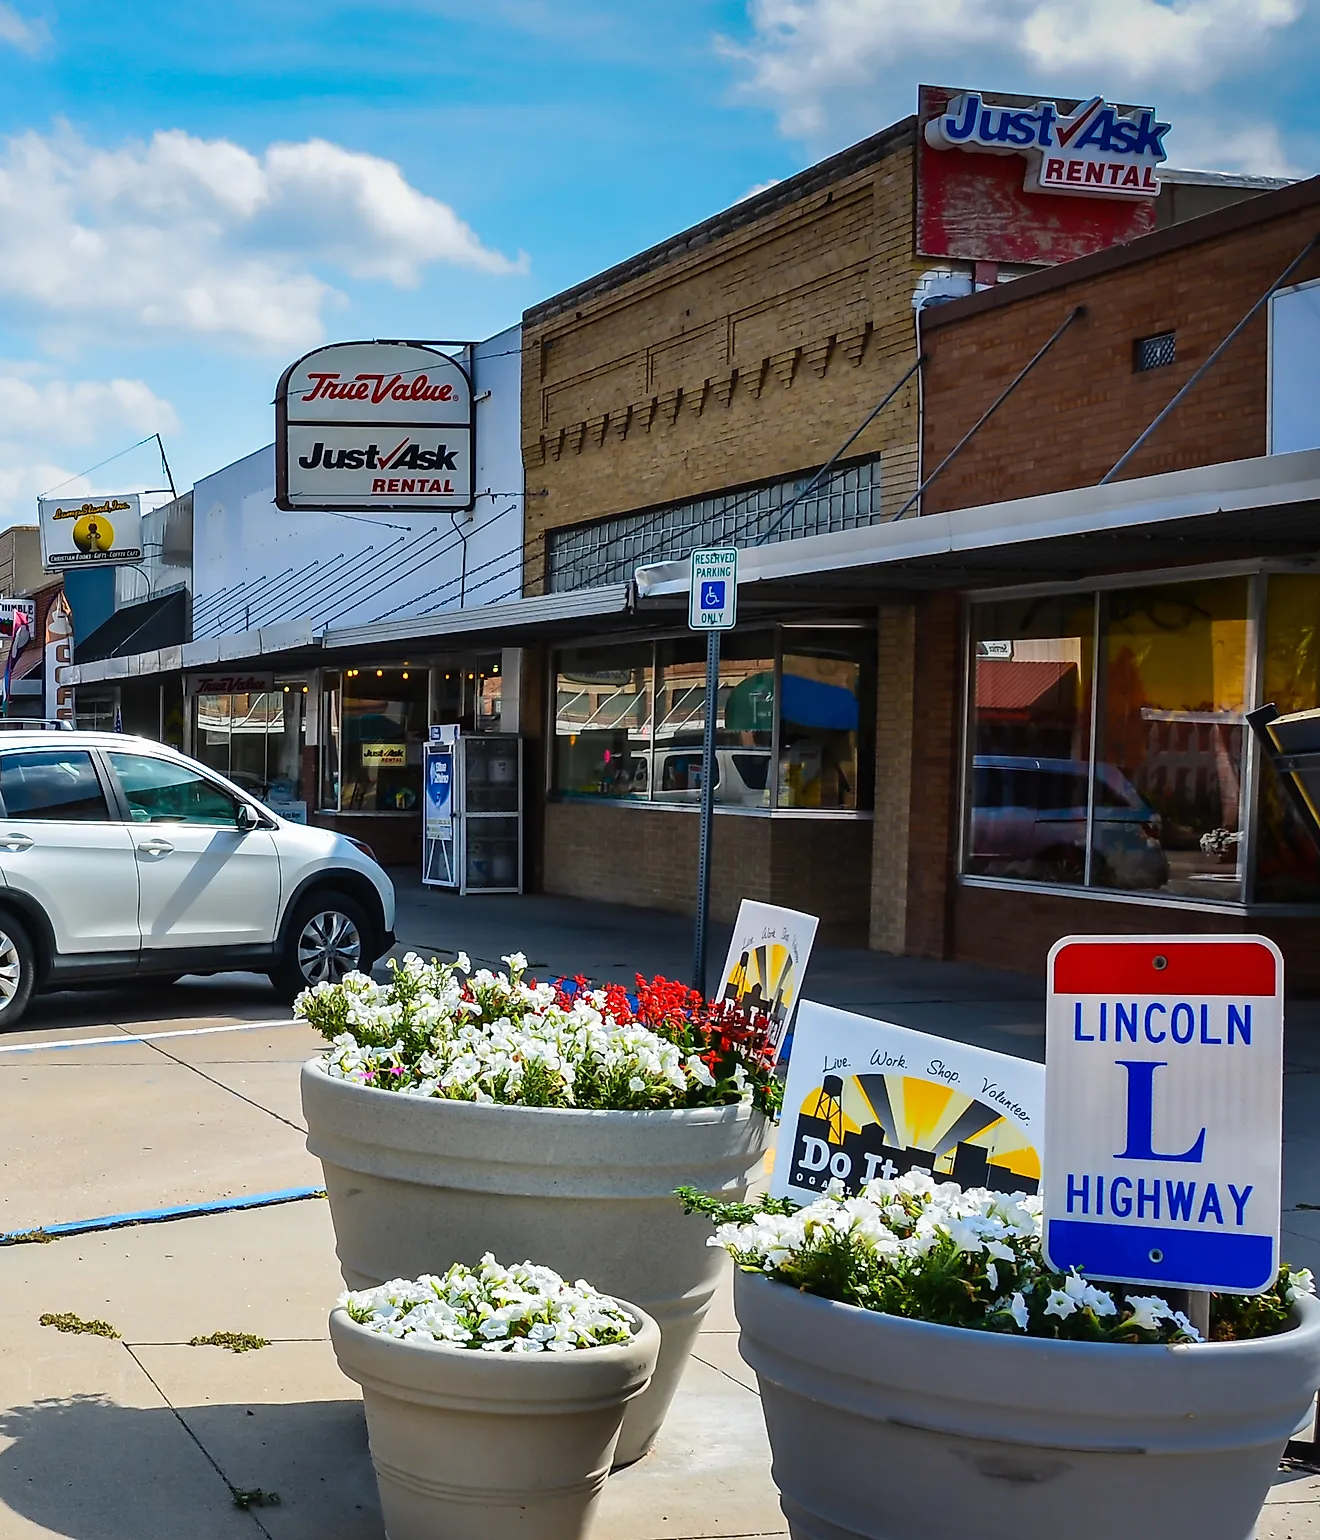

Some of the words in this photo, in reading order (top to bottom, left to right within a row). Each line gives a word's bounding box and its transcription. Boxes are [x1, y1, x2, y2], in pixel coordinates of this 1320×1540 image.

[946, 97, 1056, 146] Just
[1073, 109, 1171, 156] Ask
[1046, 158, 1157, 188] RENTAL
[298, 442, 380, 470] Just
[388, 443, 460, 471] Ask
[371, 478, 455, 493] RENTAL
[695, 553, 735, 564] RESERVED
[696, 566, 731, 577] PARKING
[701, 612, 724, 624] ONLY
[364, 749, 383, 757] Just
[386, 749, 404, 757] Ask
[1074, 1002, 1252, 1045] LINCOLN
[822, 1055, 852, 1073] Live.
[870, 1049, 908, 1069] Work.
[926, 1059, 961, 1083] Shop.
[982, 1077, 1031, 1127] Volunteer.
[1112, 1060, 1206, 1163] L
[798, 1134, 852, 1179] Do
[860, 1152, 899, 1185] It
[1066, 1173, 1254, 1226] HIGHWAY
